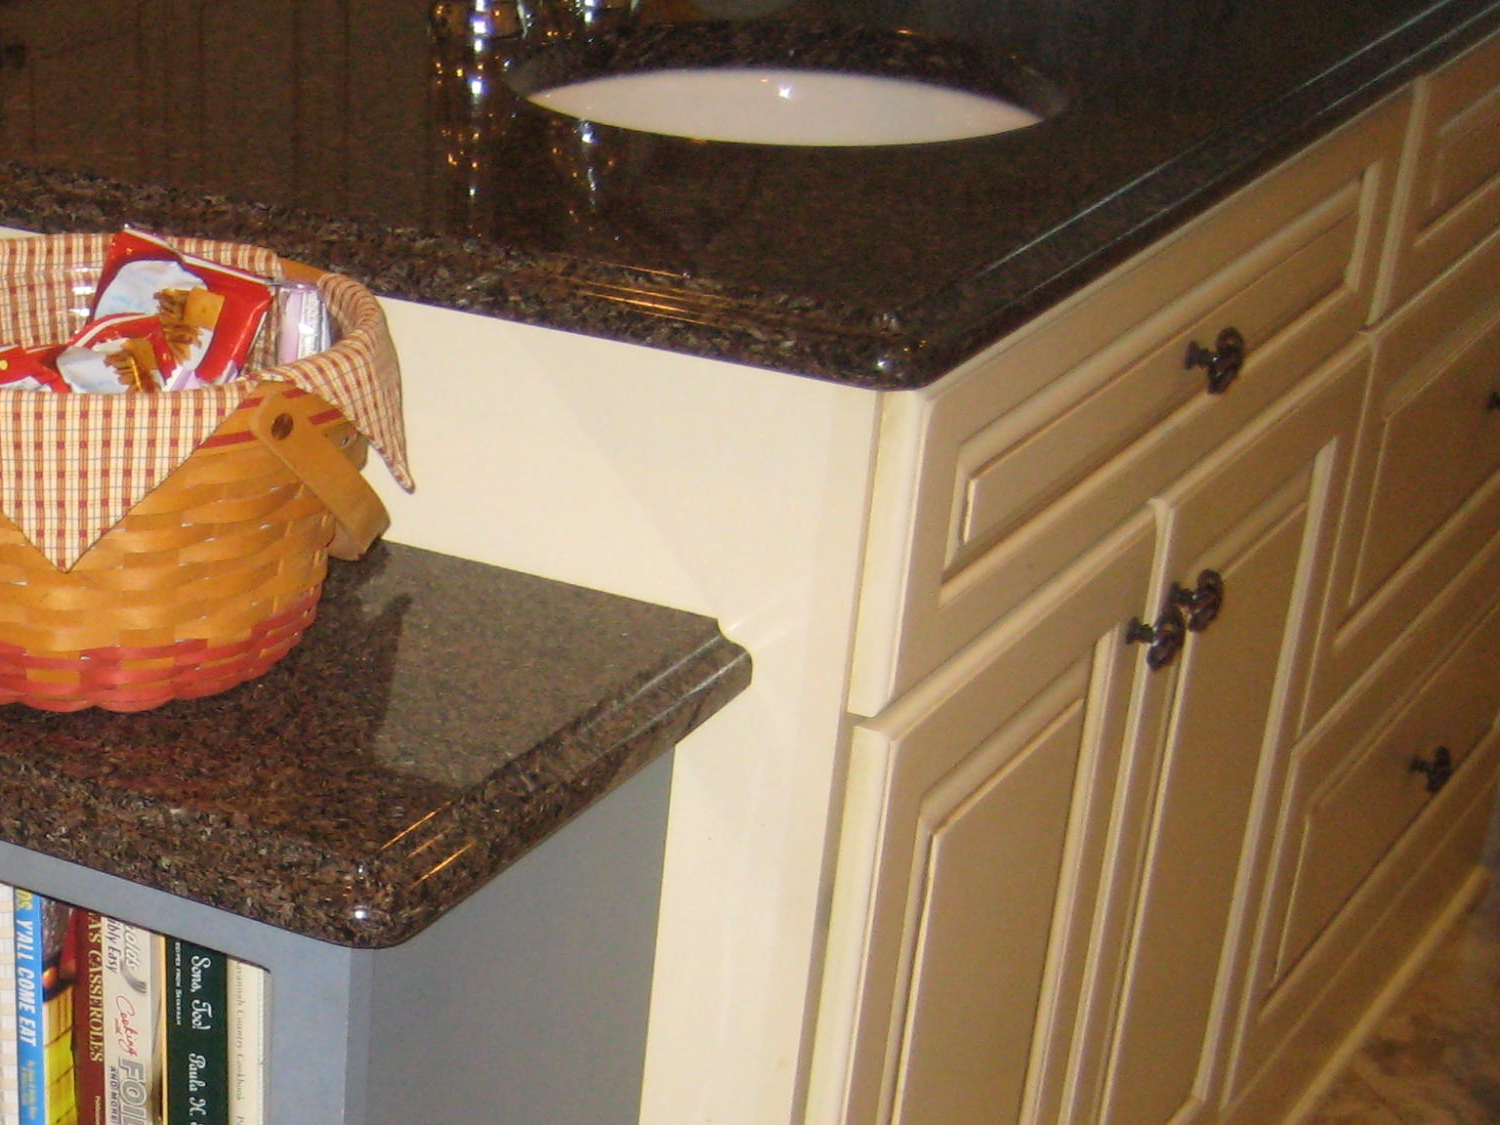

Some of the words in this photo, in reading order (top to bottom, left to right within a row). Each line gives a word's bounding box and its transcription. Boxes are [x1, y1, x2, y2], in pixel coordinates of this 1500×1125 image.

[16, 919, 35, 960] Y'ALL
[106, 946, 121, 974] Easy
[190, 955, 212, 992] Sons,
[19, 967, 35, 1013] COME
[88, 949, 103, 1062] CASSEROLES
[20, 1018, 36, 1047] EAT
[116, 996, 139, 1056] Cooking
[192, 1000, 213, 1030] Too!
[235, 1010, 246, 1049] Country
[188, 1053, 206, 1091] Paula
[235, 1053, 247, 1101] Cookbook
[110, 1092, 119, 1124] MORE!
[189, 1097, 206, 1116] H.
